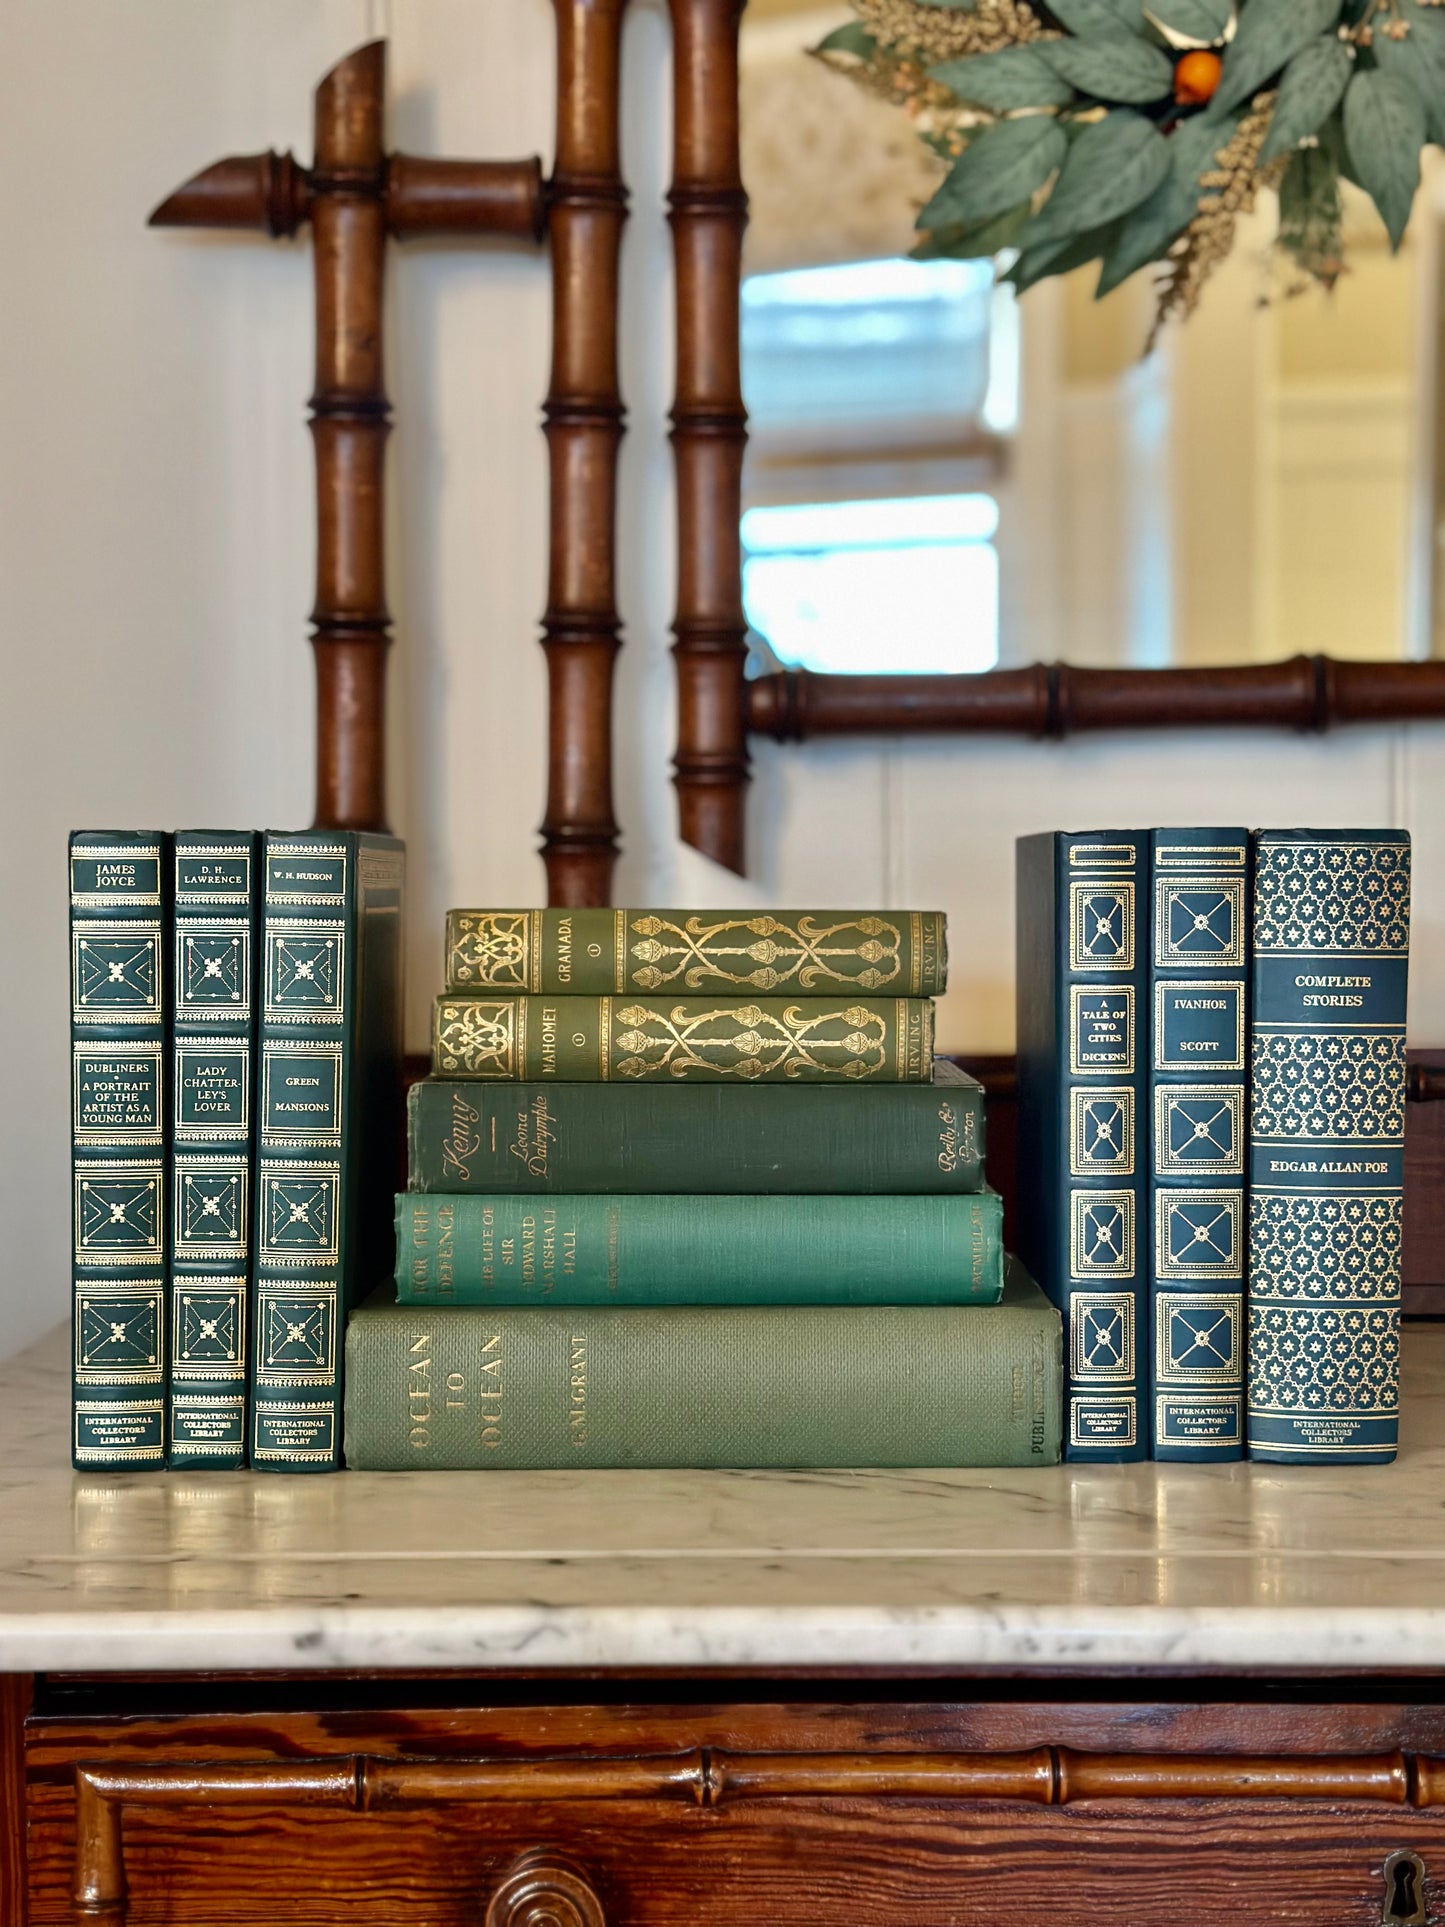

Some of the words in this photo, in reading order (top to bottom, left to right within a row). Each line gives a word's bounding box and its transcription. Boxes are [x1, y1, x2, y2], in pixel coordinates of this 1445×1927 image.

[96, 864, 136, 875] JAMES
[201, 866, 211, 874] D.
[214, 866, 225, 874] H.
[184, 876, 242, 884] LAWRENCE
[273, 872, 284, 880] W.
[285, 872, 295, 880] H.
[296, 872, 333, 881] HUDSON
[96, 876, 136, 888] JOYCE
[558, 918, 572, 982] GRANADA
[1294, 976, 1372, 988] COMPLETE
[1100, 1000, 1108, 1008] A
[1174, 1000, 1227, 1009] IVANHOE
[1302, 996, 1363, 1006] STORIES
[1082, 1011, 1110, 1020] TALE
[1112, 1011, 1126, 1019] OF
[1092, 1023, 1117, 1031] TWO
[542, 1007, 556, 1073] MAHOMET
[1087, 1034, 1122, 1042] CITIES
[909, 1014, 920, 1075] IRVING
[1180, 1042, 1219, 1051] SCOTT
[1082, 1053, 1126, 1061] DICKENS
[85, 1064, 150, 1074] DUBLINERS
[196, 1067, 228, 1076] LADY
[82, 1082, 90, 1091] A
[93, 1082, 152, 1091] PORTRAIT
[184, 1078, 242, 1088] CHATTER-
[285, 1078, 320, 1086] GREEN
[95, 1093, 112, 1102] OF
[114, 1093, 140, 1102] THE
[198, 1091, 227, 1100] LEY'S
[83, 1104, 124, 1112] ARTIST
[126, 1104, 140, 1112] AS
[142, 1104, 150, 1112] A
[194, 1102, 231, 1112] LOVER
[275, 1103, 330, 1112] MANSIONS
[82, 1114, 122, 1124] YOUNG
[124, 1114, 152, 1124] MAN
[442, 1093, 481, 1181] Kenny
[510, 1112, 529, 1163] Leona
[528, 1095, 557, 1180] Dalrymple
[938, 1126, 960, 1173] Reilly
[1270, 1161, 1318, 1173] EDGAR
[1320, 1162, 1362, 1173] ALLAN
[1364, 1162, 1388, 1173] POE
[482, 1206, 494, 1226] OF
[482, 1229, 494, 1262] LIFE
[437, 1204, 454, 1297] DEFENCE
[502, 1238, 514, 1266] SIR
[522, 1215, 536, 1286] EDWARD
[562, 1230, 576, 1274] HALL
[412, 1257, 429, 1295] FOR
[408, 1334, 432, 1448] OCEAN
[446, 1372, 466, 1410] TO
[480, 1334, 504, 1448] OCEAN
[176, 1412, 239, 1420] INTERNATIONAL
[1080, 1412, 1128, 1420] INTERNATIONAL
[1169, 1408, 1235, 1416] INTERNATIONAL
[85, 1417, 153, 1425] INTERNATIONAL
[183, 1421, 232, 1429] COLLECTORS
[263, 1420, 326, 1428] INTERNATIONAL
[1292, 1420, 1360, 1428] INTERNATIONAL
[91, 1426, 146, 1434] COLLECTORS
[190, 1430, 224, 1438] LIBRARY
[1184, 1426, 1220, 1434] LIBRARY
[100, 1436, 136, 1444] LIBRARY
[1308, 1436, 1346, 1444] LIBRARY
